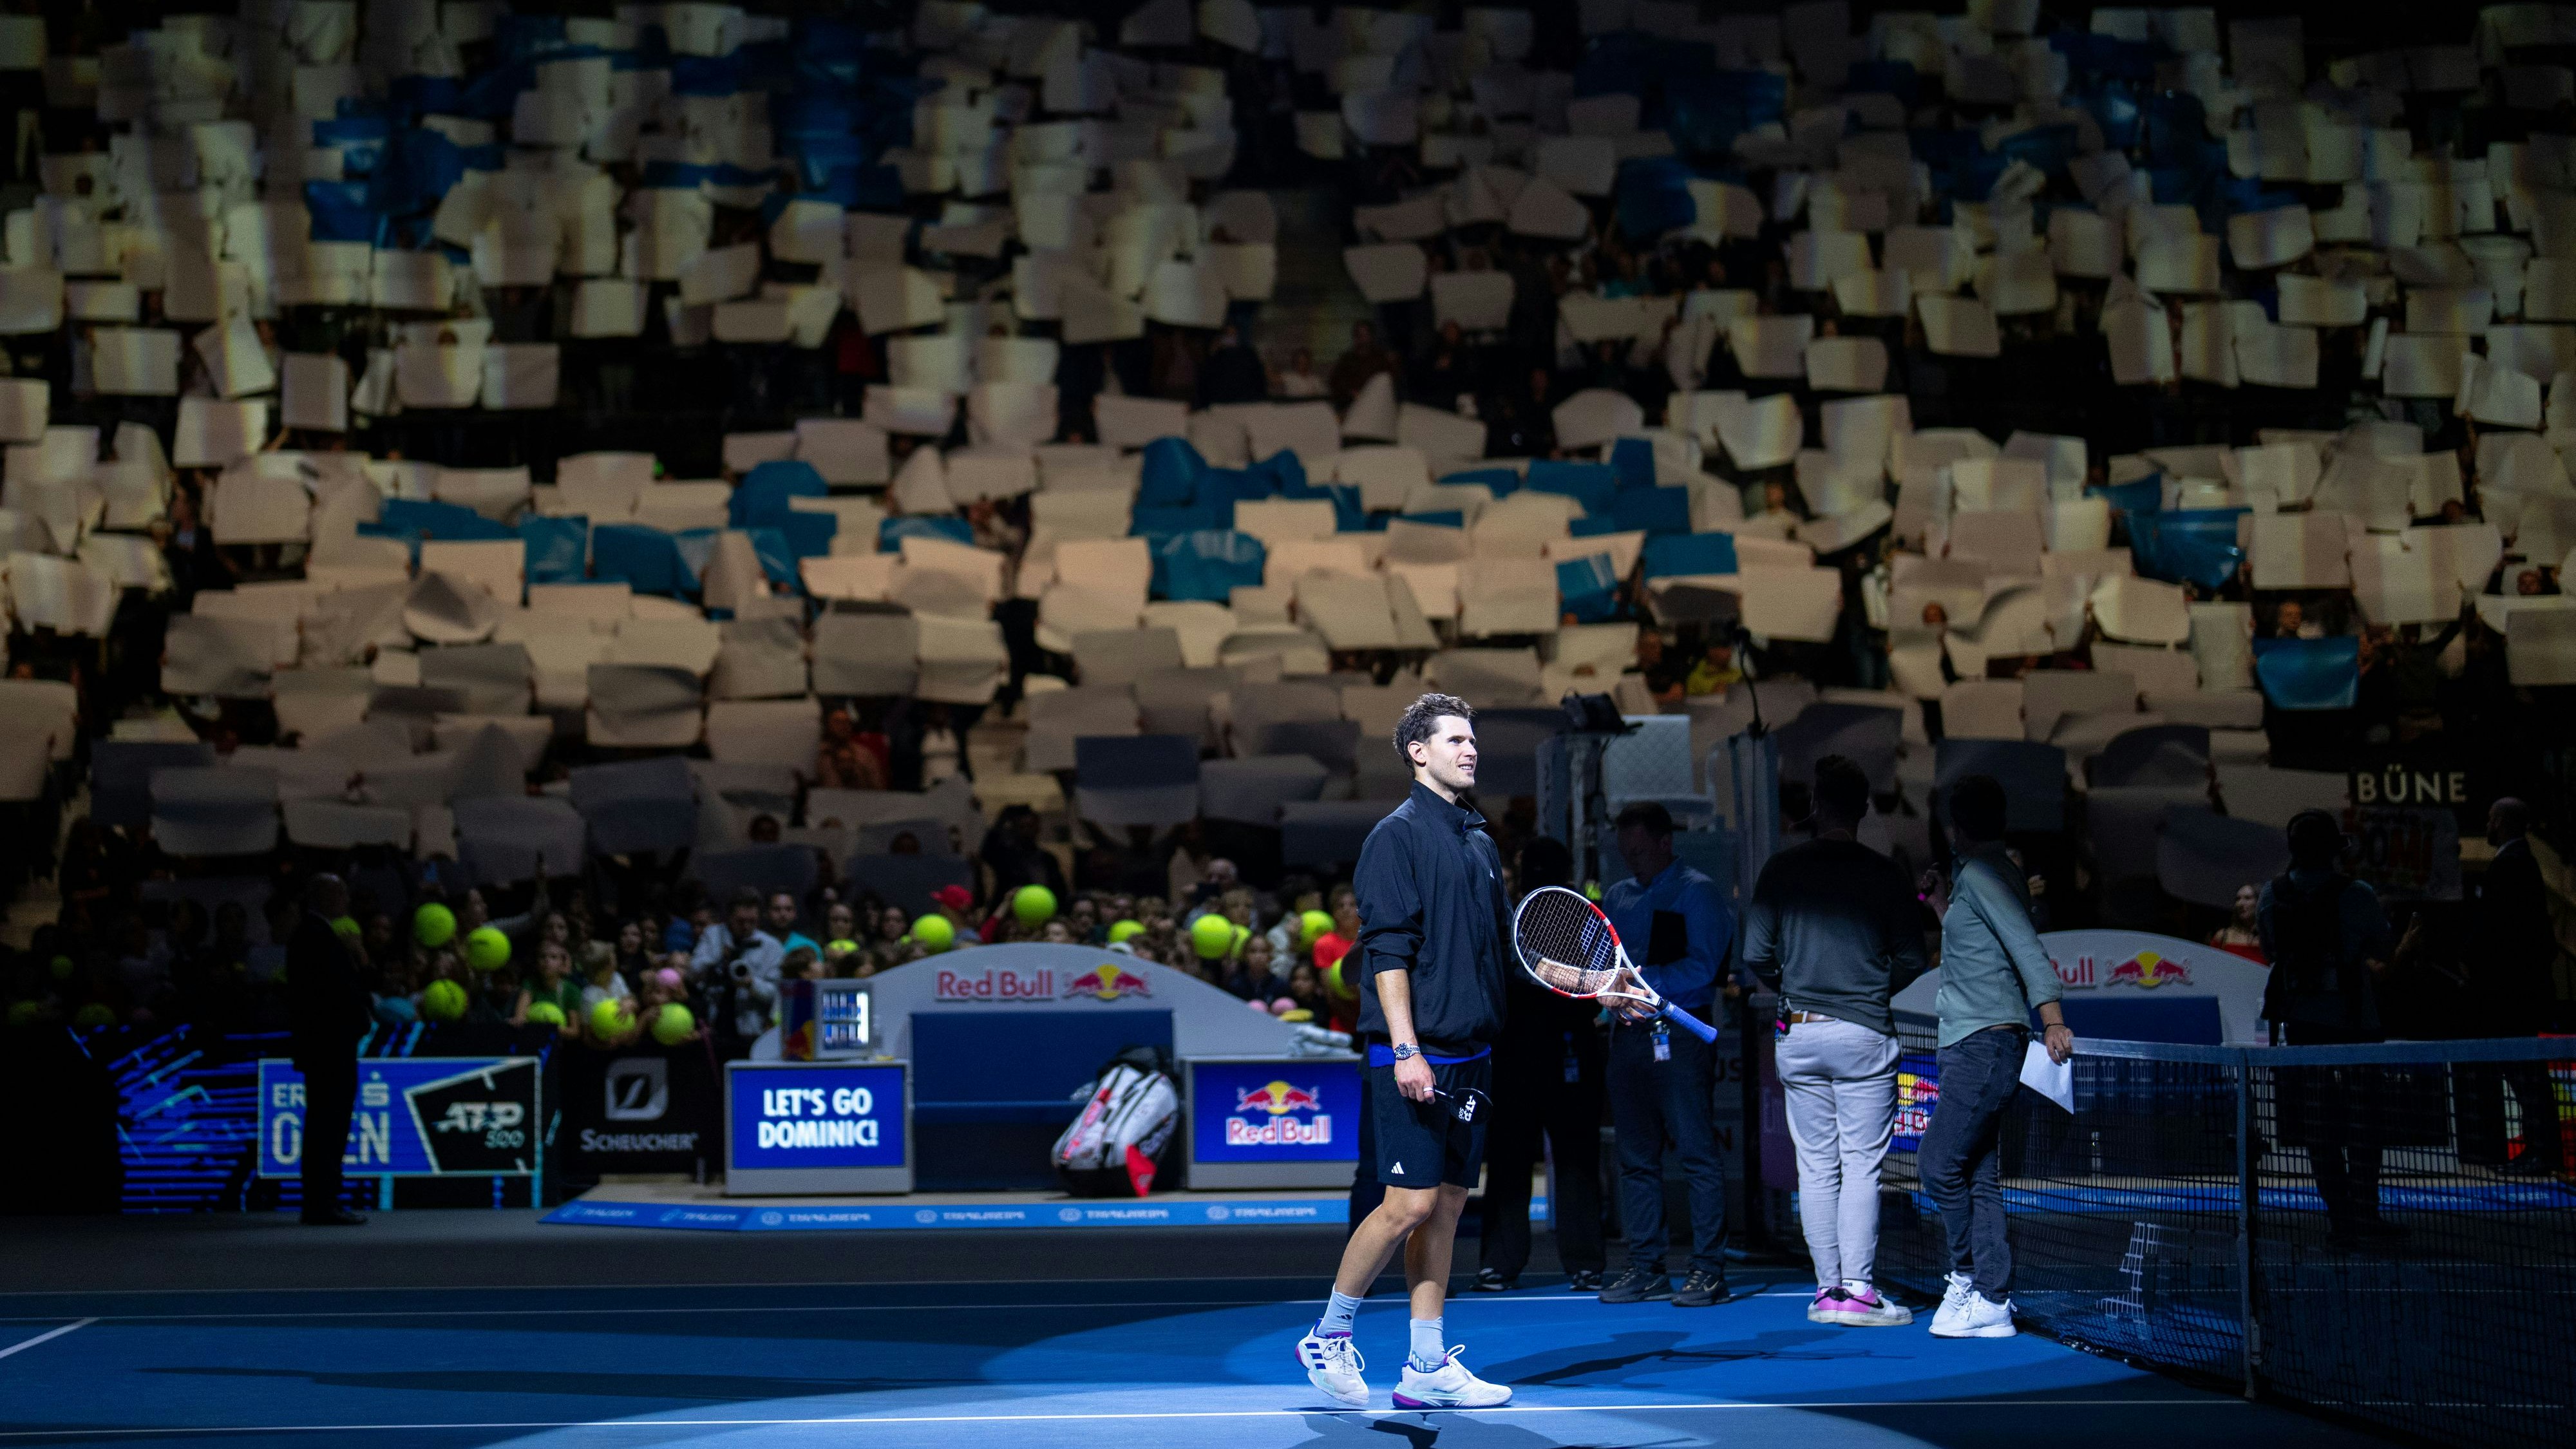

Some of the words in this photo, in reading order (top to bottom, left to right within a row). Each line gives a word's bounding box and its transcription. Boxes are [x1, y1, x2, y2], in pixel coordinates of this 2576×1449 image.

[937, 969, 992, 996] Red
[1000, 969, 1054, 996] Bull
[433, 1101, 525, 1132] ATP
[763, 1087, 827, 1117] LET'S
[831, 1086, 873, 1117] GO
[272, 1112, 390, 1165] ON
[484, 1130, 525, 1148] 500
[757, 1119, 879, 1149] DOMINIC!
[1226, 1115, 1278, 1145] Red
[1280, 1115, 1331, 1144] Bull
